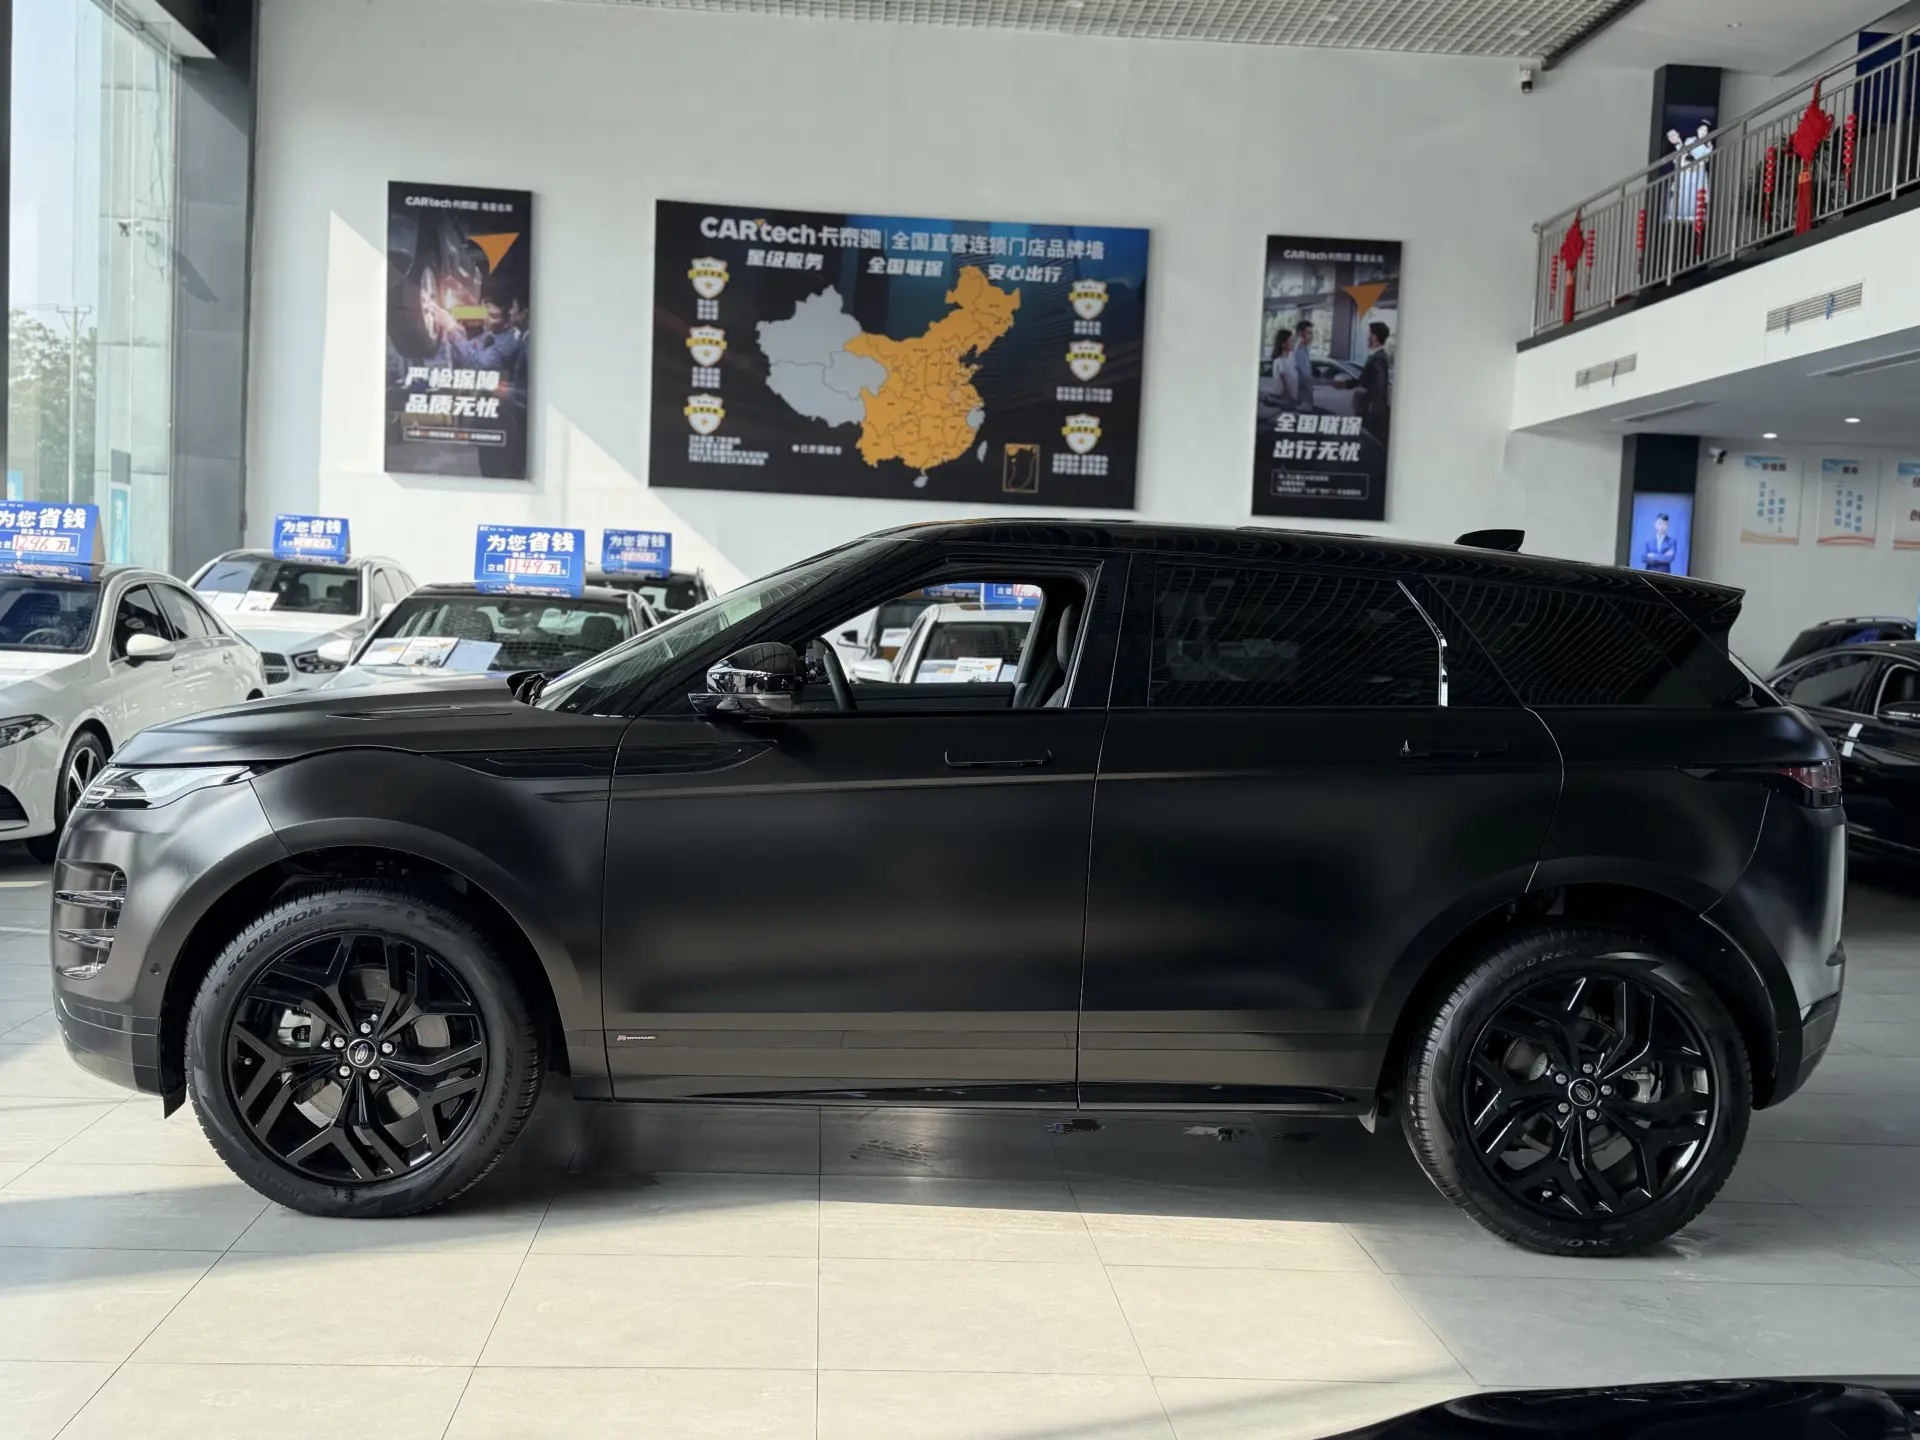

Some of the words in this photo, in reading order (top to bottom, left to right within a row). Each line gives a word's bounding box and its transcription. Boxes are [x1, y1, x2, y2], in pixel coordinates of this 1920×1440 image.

[700, 216, 817, 245] CARtech
[892, 231, 1104, 260] 全国直营连锁门店品牌墙
[746, 249, 824, 271] 星级服务
[867, 257, 944, 277] 全国联保
[988, 264, 1063, 283] 安心出行
[405, 366, 500, 391] 严检保障
[405, 393, 500, 418] 品质无忧
[1274, 412, 1363, 436] 全国联保
[1273, 439, 1361, 462] 出行无忧
[0, 507, 87, 529] 为您省钱
[486, 532, 575, 552] 为您省钱
[226, 904, 325, 977] SCORPION
